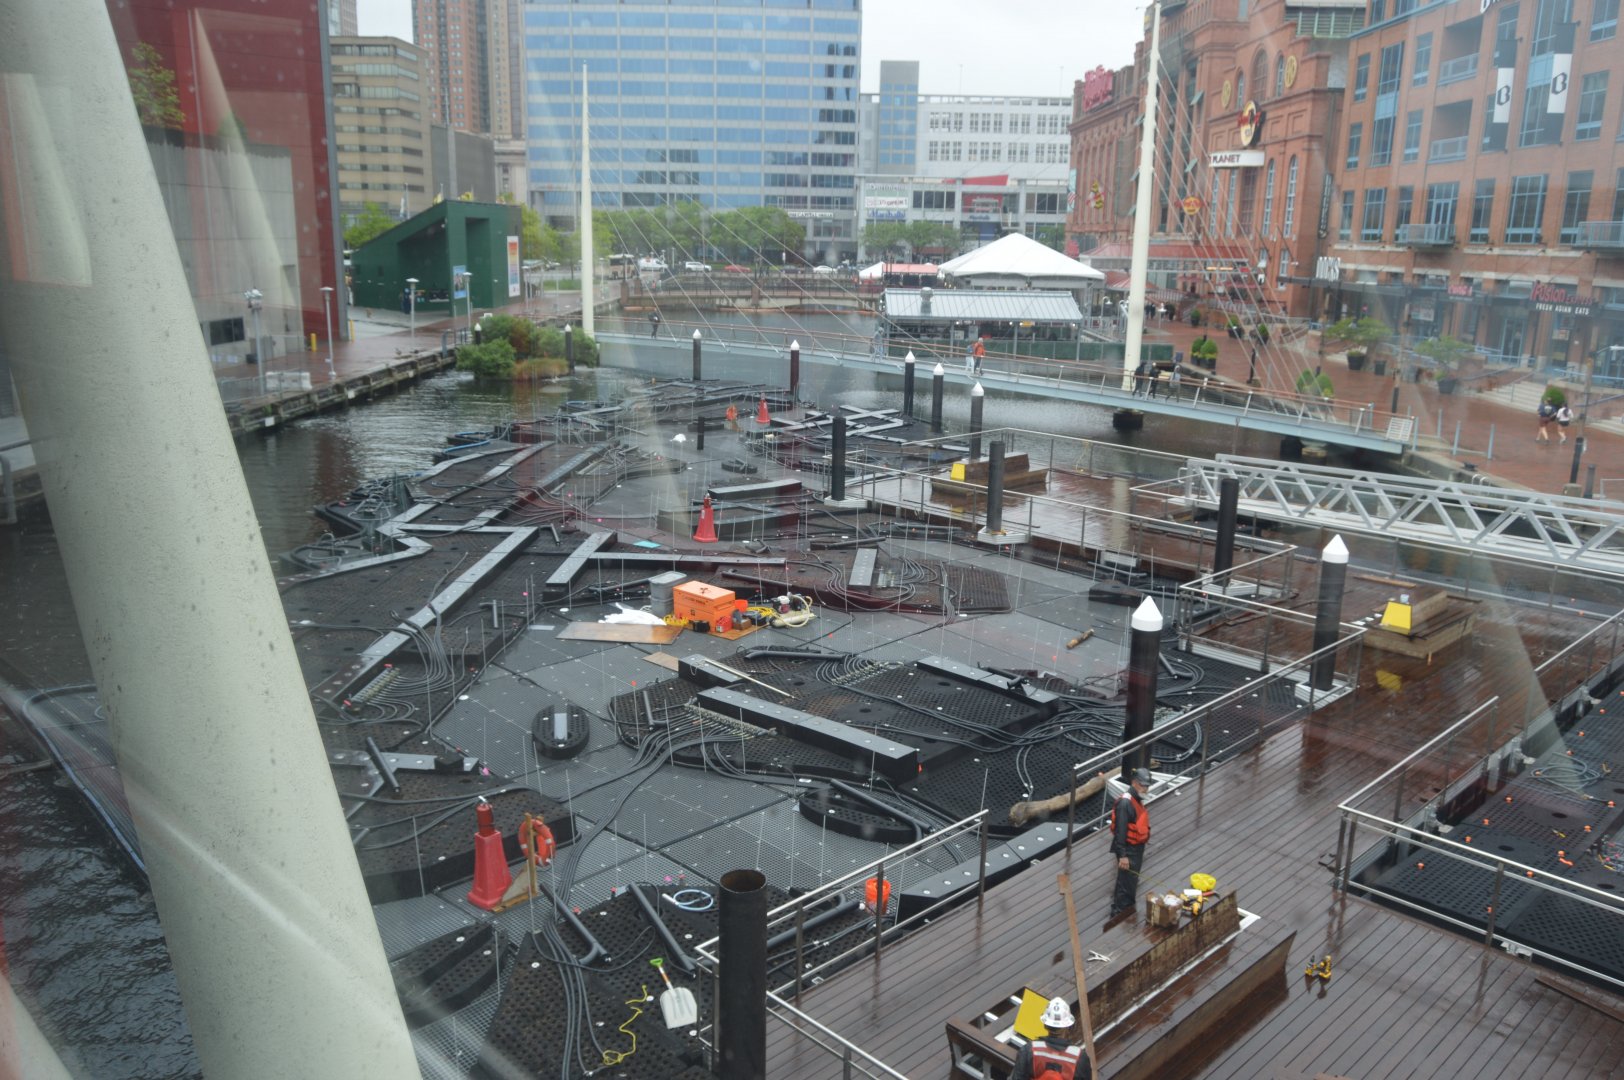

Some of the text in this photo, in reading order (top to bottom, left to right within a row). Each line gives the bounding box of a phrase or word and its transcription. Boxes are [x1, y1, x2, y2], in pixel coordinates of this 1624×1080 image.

[1552, 72, 1567, 95] B
[1497, 85, 1511, 106] B
[1575, 307, 1589, 315] EATS
